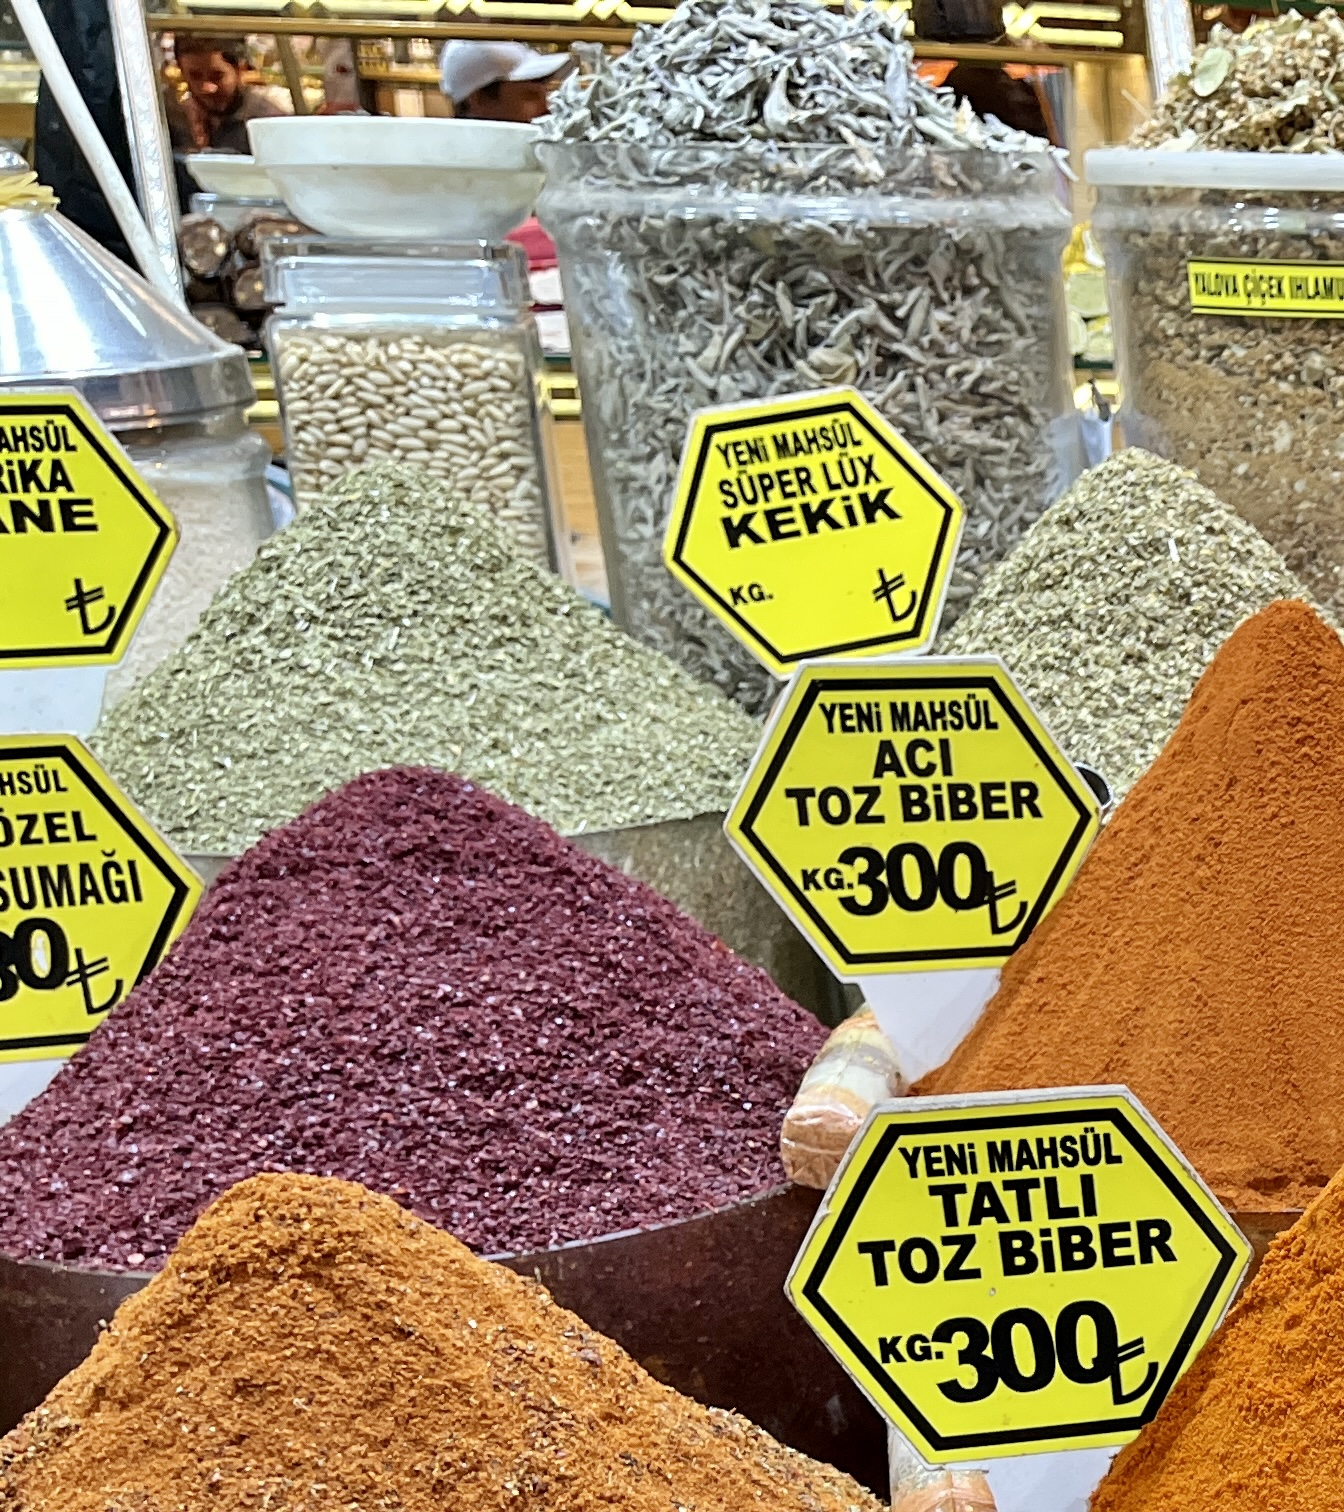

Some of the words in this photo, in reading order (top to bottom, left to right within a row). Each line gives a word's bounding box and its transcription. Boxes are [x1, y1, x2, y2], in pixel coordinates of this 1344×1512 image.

[772, 418, 862, 458] MAHSÜL
[719, 469, 818, 509] SÜPER
[823, 452, 882, 490] LÜX
[729, 583, 774, 607] KG.
[890, 694, 998, 732] MAHSÜL
[873, 738, 953, 778] ACI
[786, 785, 885, 827] TOZ
[987, 1127, 1122, 1174] MAHSÜL
[929, 1173, 1099, 1228] TATLI
[857, 1234, 982, 1287] TOZ
